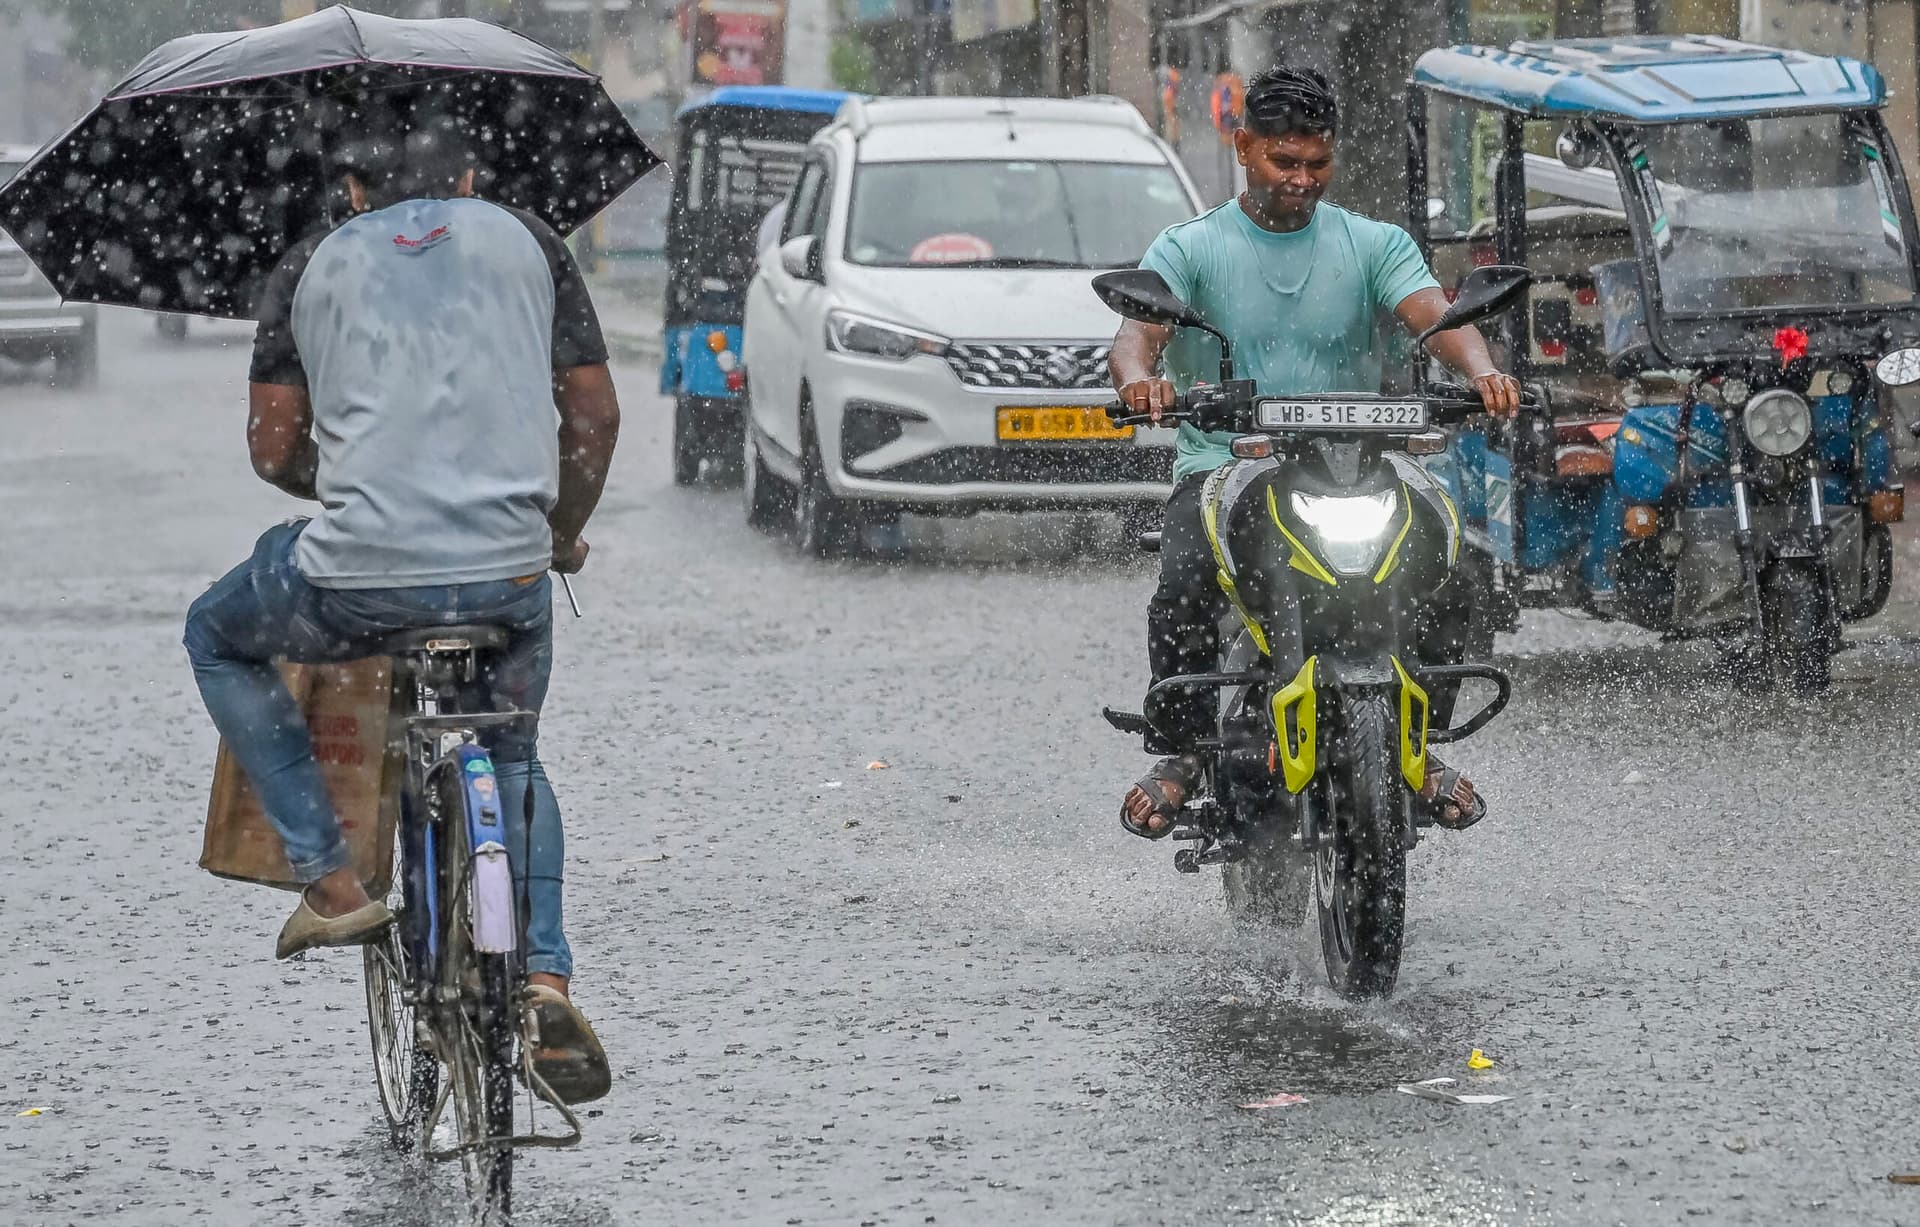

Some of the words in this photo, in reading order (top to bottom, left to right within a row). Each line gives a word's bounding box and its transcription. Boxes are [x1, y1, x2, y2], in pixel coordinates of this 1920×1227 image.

[1281, 406, 1304, 423] WB
[1321, 406, 1357, 423] 51E
[1371, 407, 1419, 424] 2322
